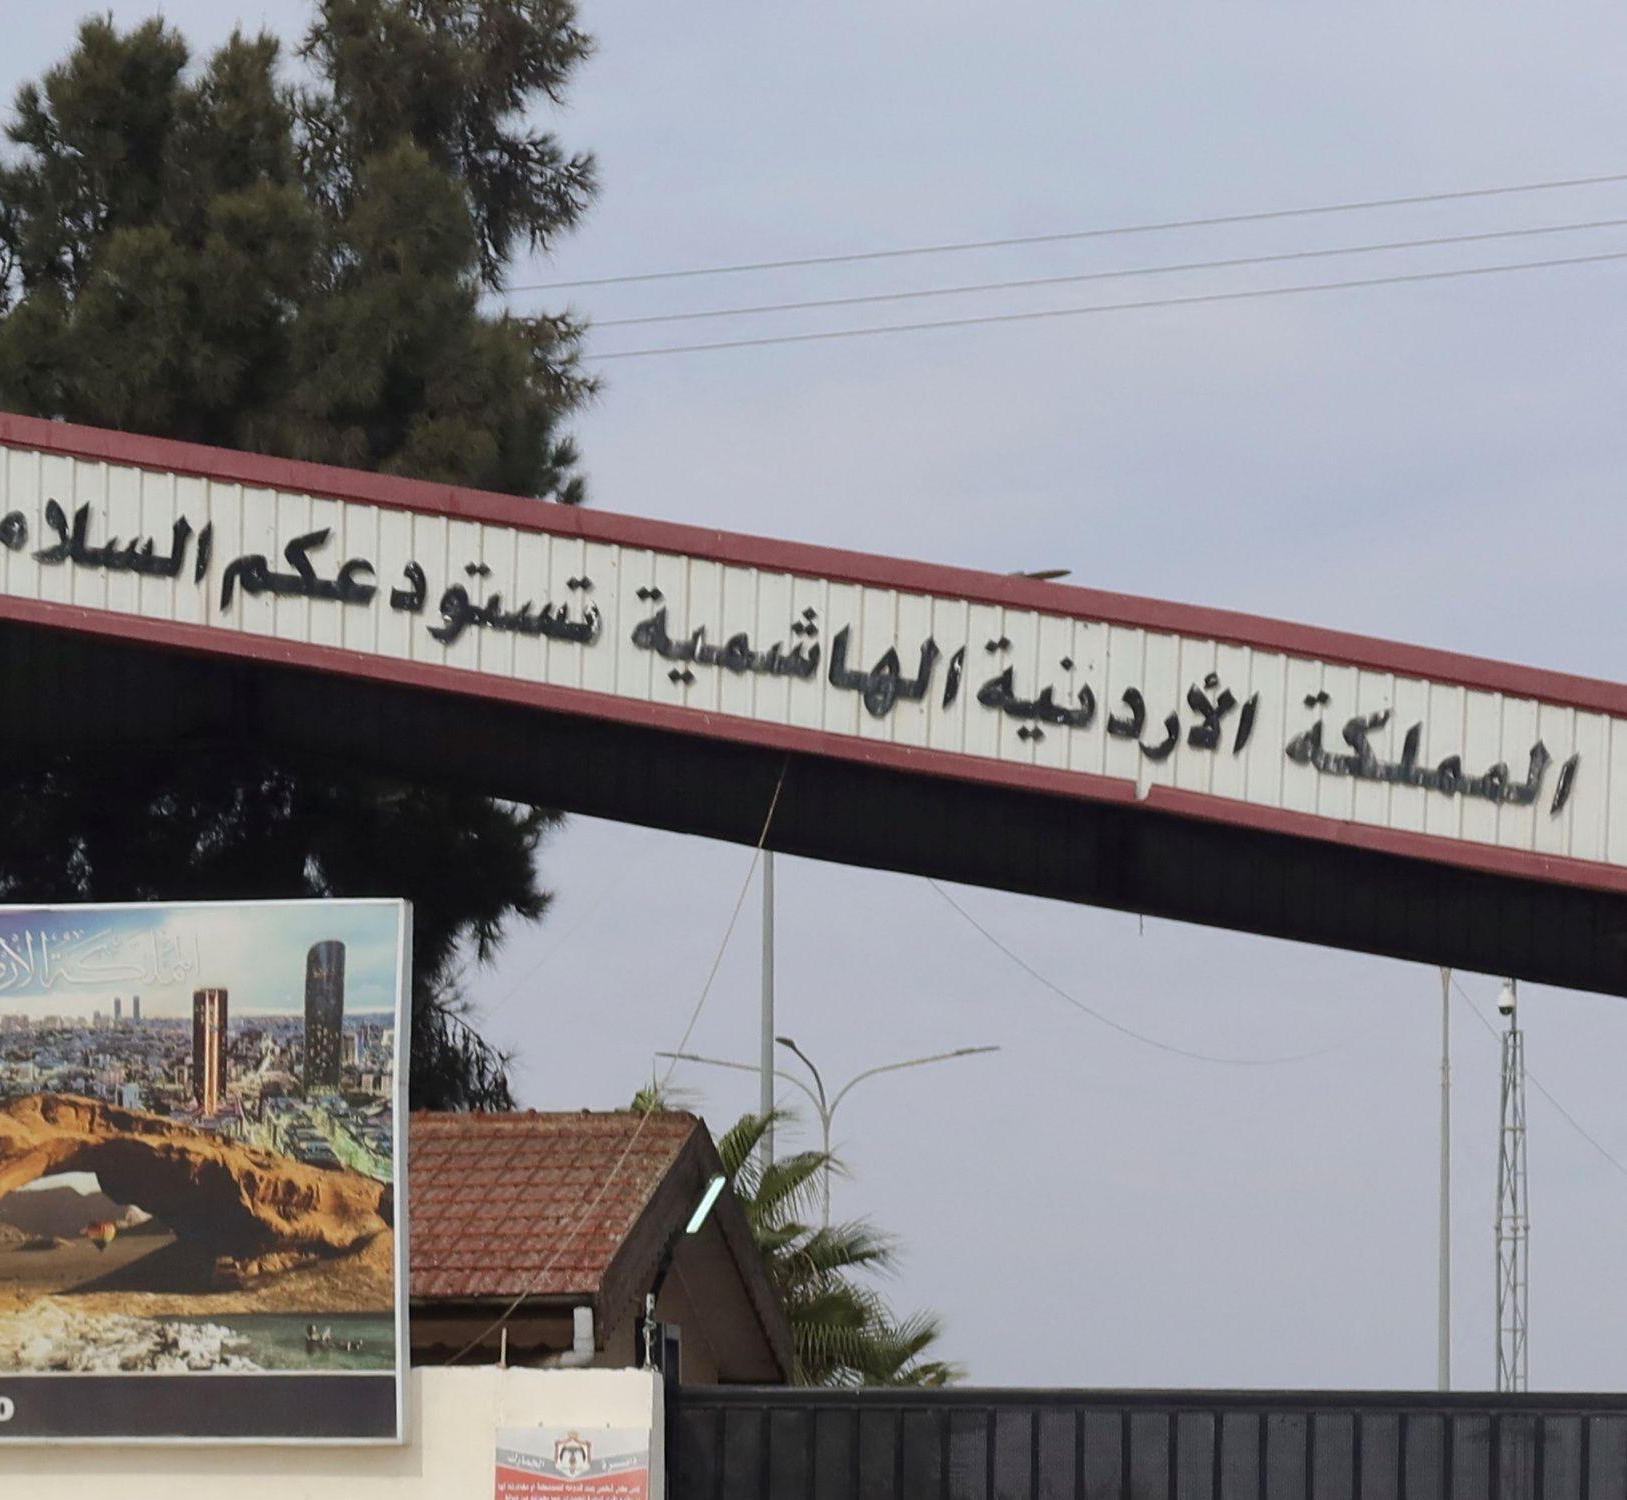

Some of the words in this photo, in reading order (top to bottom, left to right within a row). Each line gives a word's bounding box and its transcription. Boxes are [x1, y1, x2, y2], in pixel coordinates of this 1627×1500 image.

[220, 527, 602, 645] تستودعكم
[631, 587, 965, 717] الهاشمية
[977, 636, 1259, 761] الأردنية
[1287, 691, 1580, 815] المملكة
